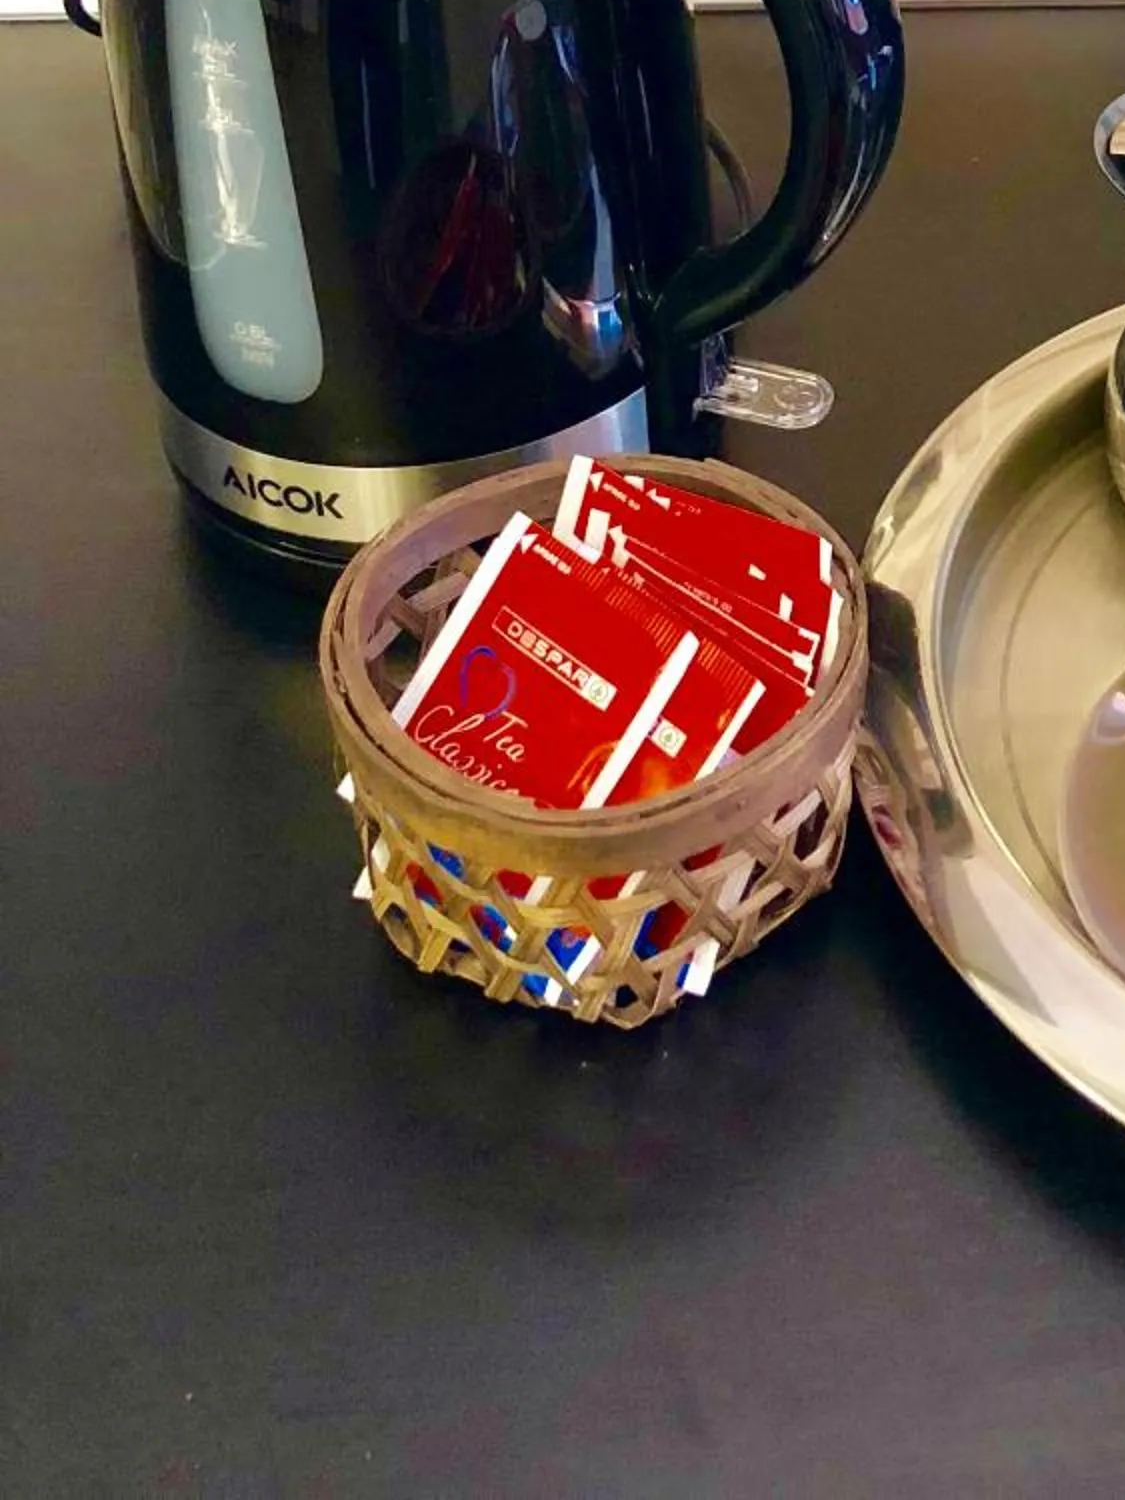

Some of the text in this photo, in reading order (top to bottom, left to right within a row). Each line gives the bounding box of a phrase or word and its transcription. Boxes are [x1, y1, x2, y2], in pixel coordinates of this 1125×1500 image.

[222, 464, 344, 519] AICOK
[506, 619, 589, 689] DESPAR
[482, 710, 529, 763] Tea
